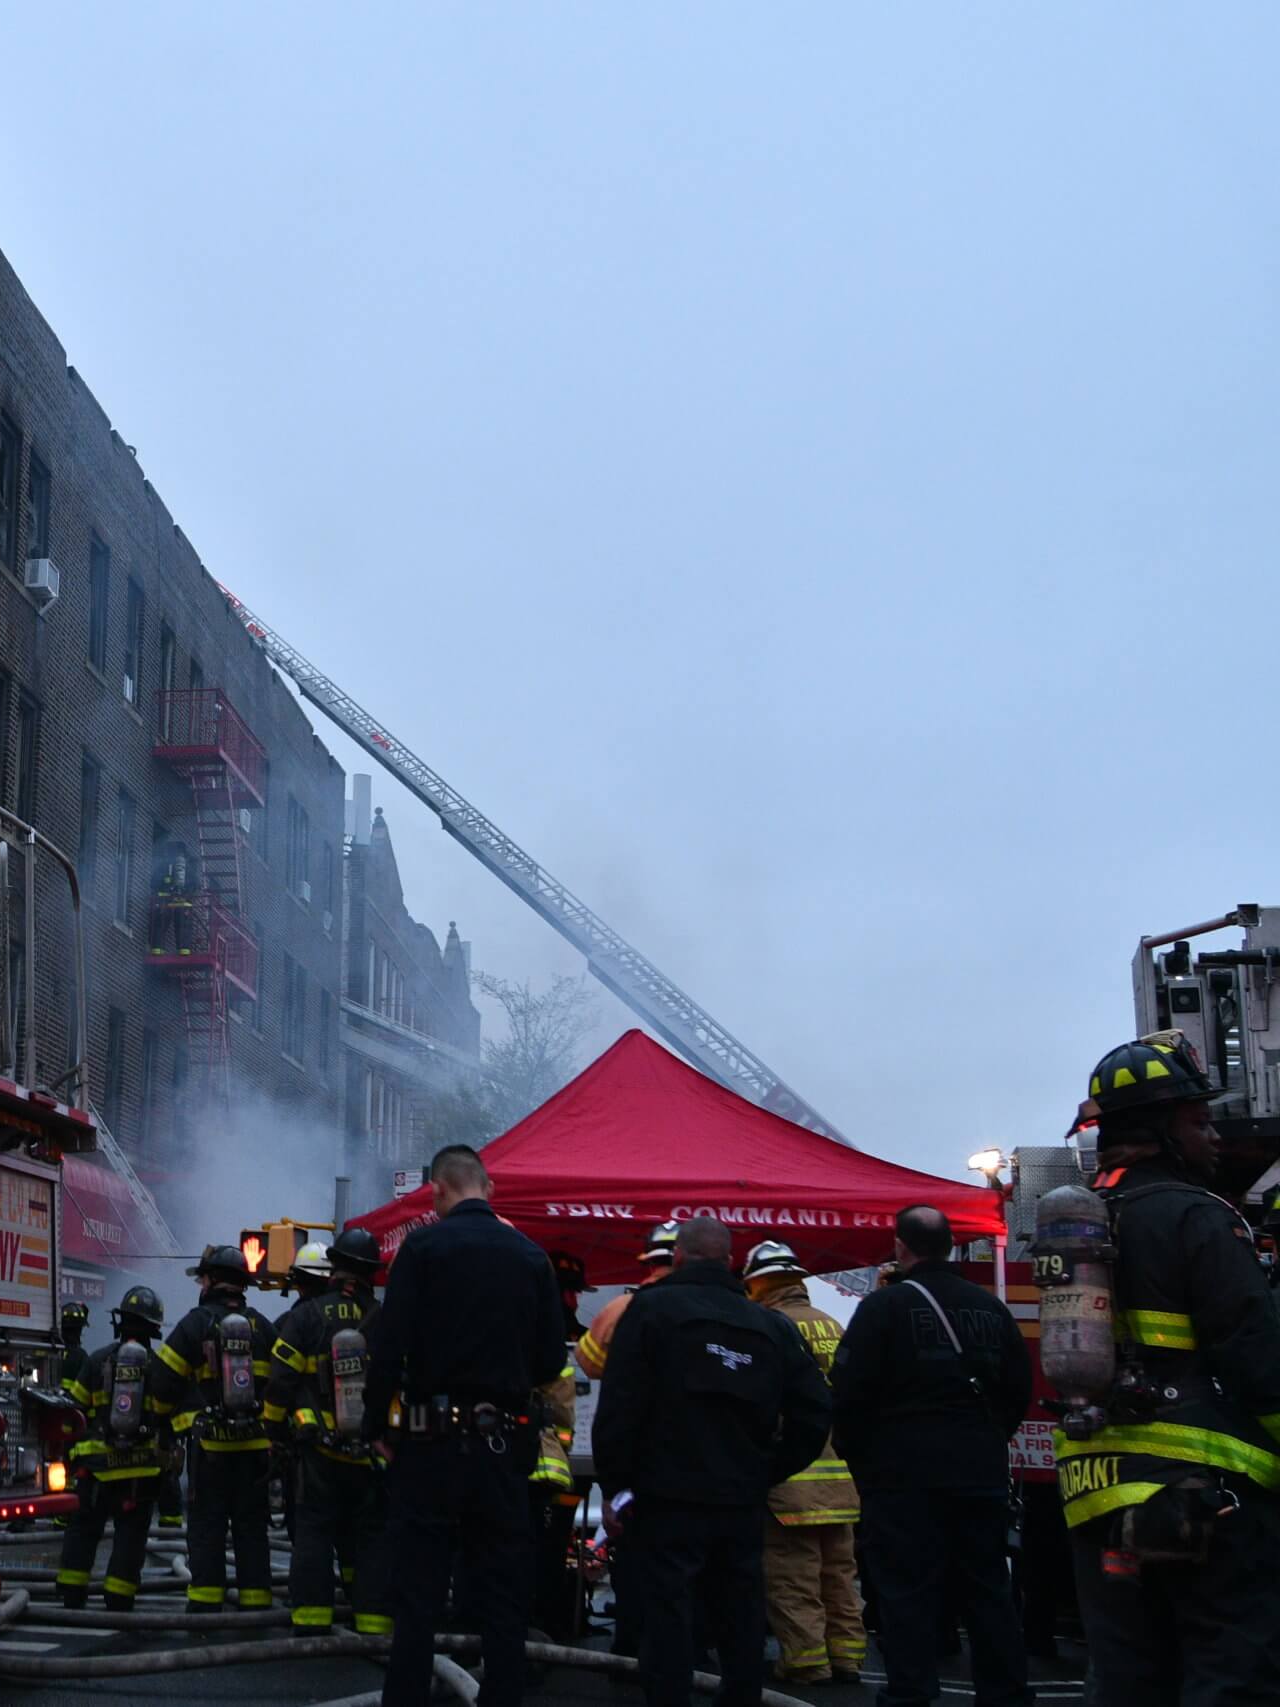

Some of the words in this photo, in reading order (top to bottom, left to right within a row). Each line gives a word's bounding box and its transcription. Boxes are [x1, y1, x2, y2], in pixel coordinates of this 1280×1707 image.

[670, 1205, 842, 1227] COMMAND
[1044, 1292, 1083, 1305] SCOTT
[335, 1359, 359, 1373] E222
